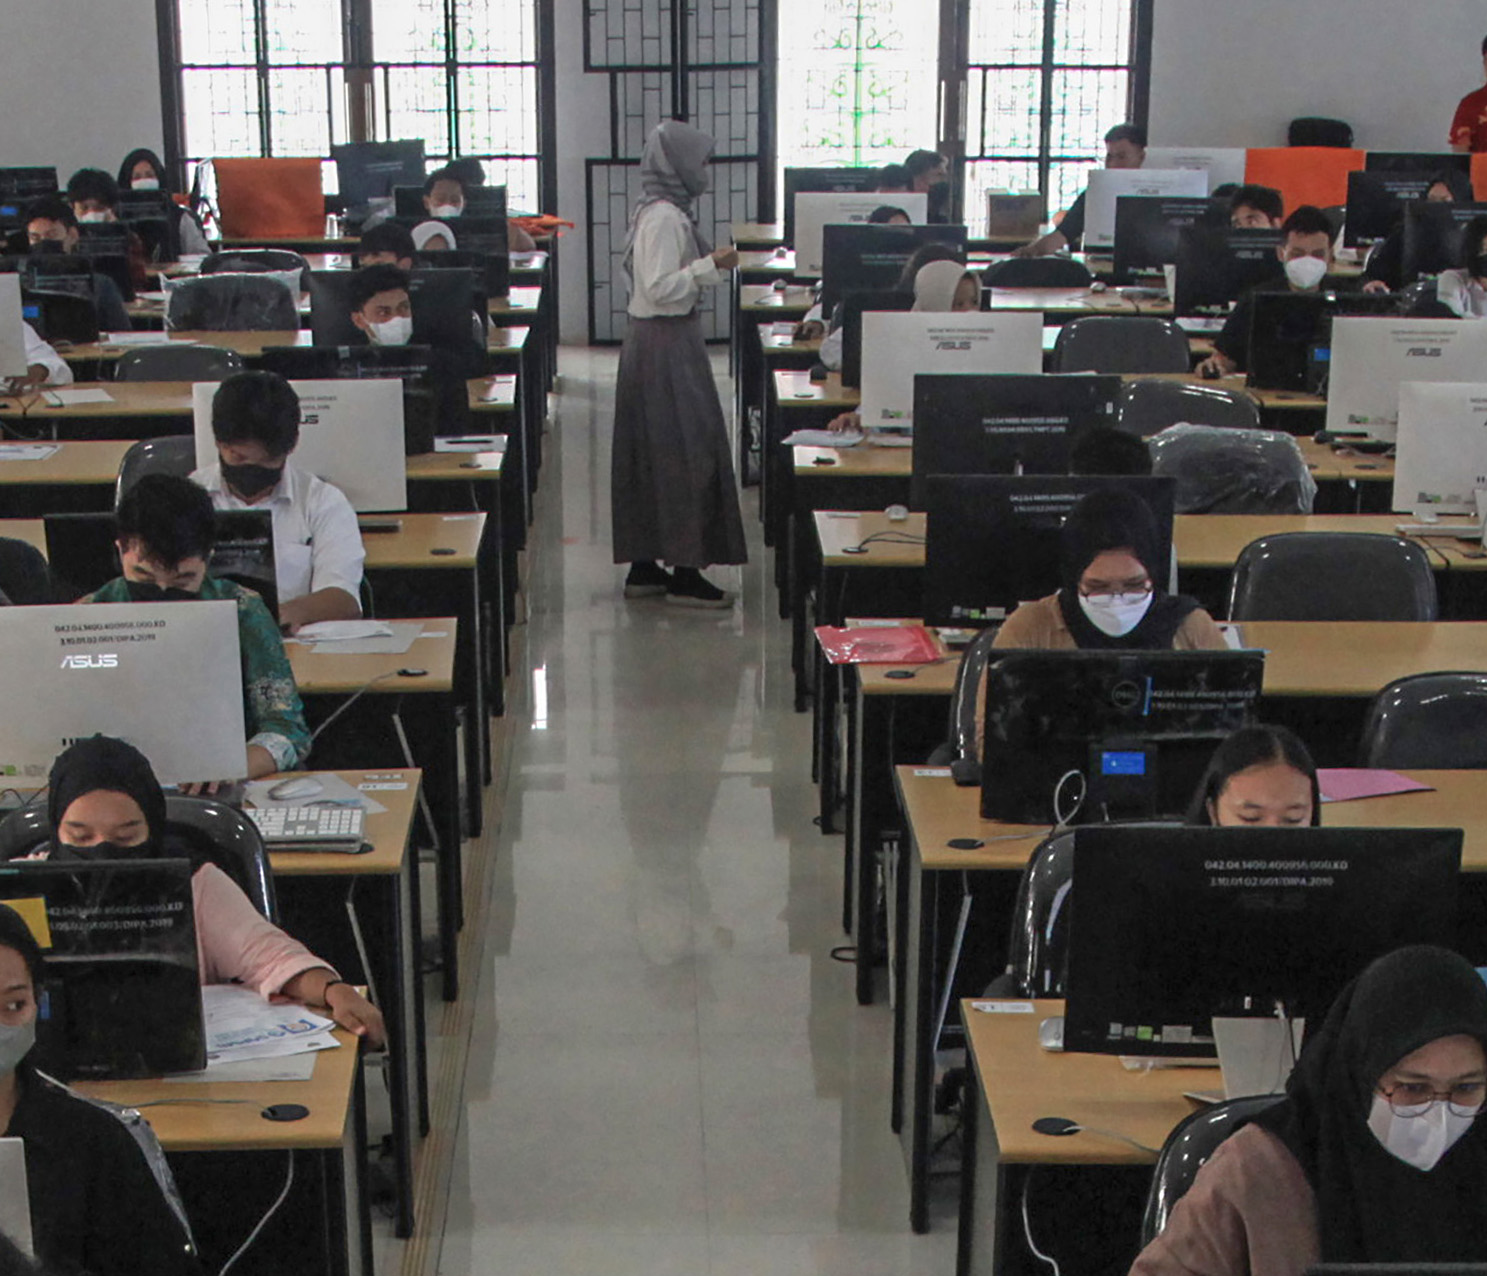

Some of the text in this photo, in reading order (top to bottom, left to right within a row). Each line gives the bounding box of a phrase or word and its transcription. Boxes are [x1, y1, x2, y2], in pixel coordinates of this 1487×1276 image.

[935, 341, 971, 351] ASUS
[1406, 347, 1442, 357] ASUS
[60, 653, 118, 668] ASUS
